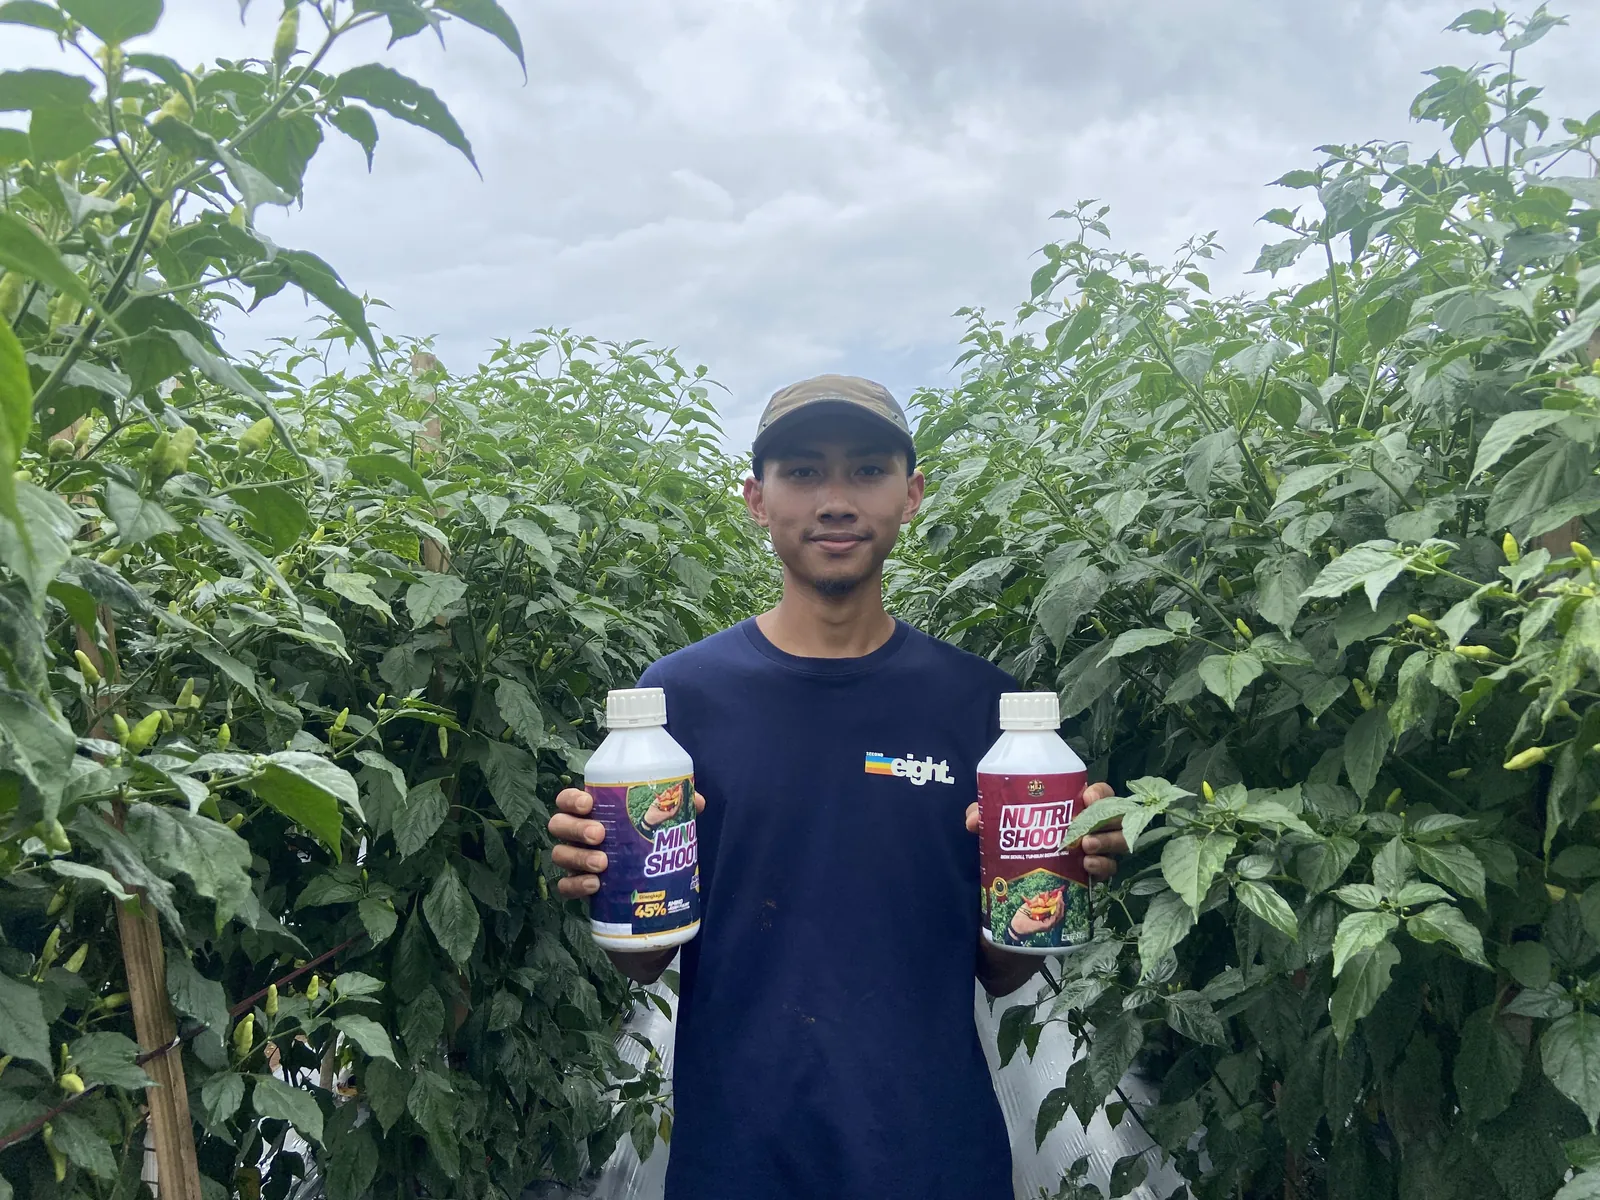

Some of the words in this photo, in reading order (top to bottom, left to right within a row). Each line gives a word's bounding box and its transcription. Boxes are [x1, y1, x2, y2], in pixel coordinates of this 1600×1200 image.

[1001, 801, 1073, 829] NUTRI
[654, 820, 697, 852] MINO
[634, 901, 667, 918] 45%
